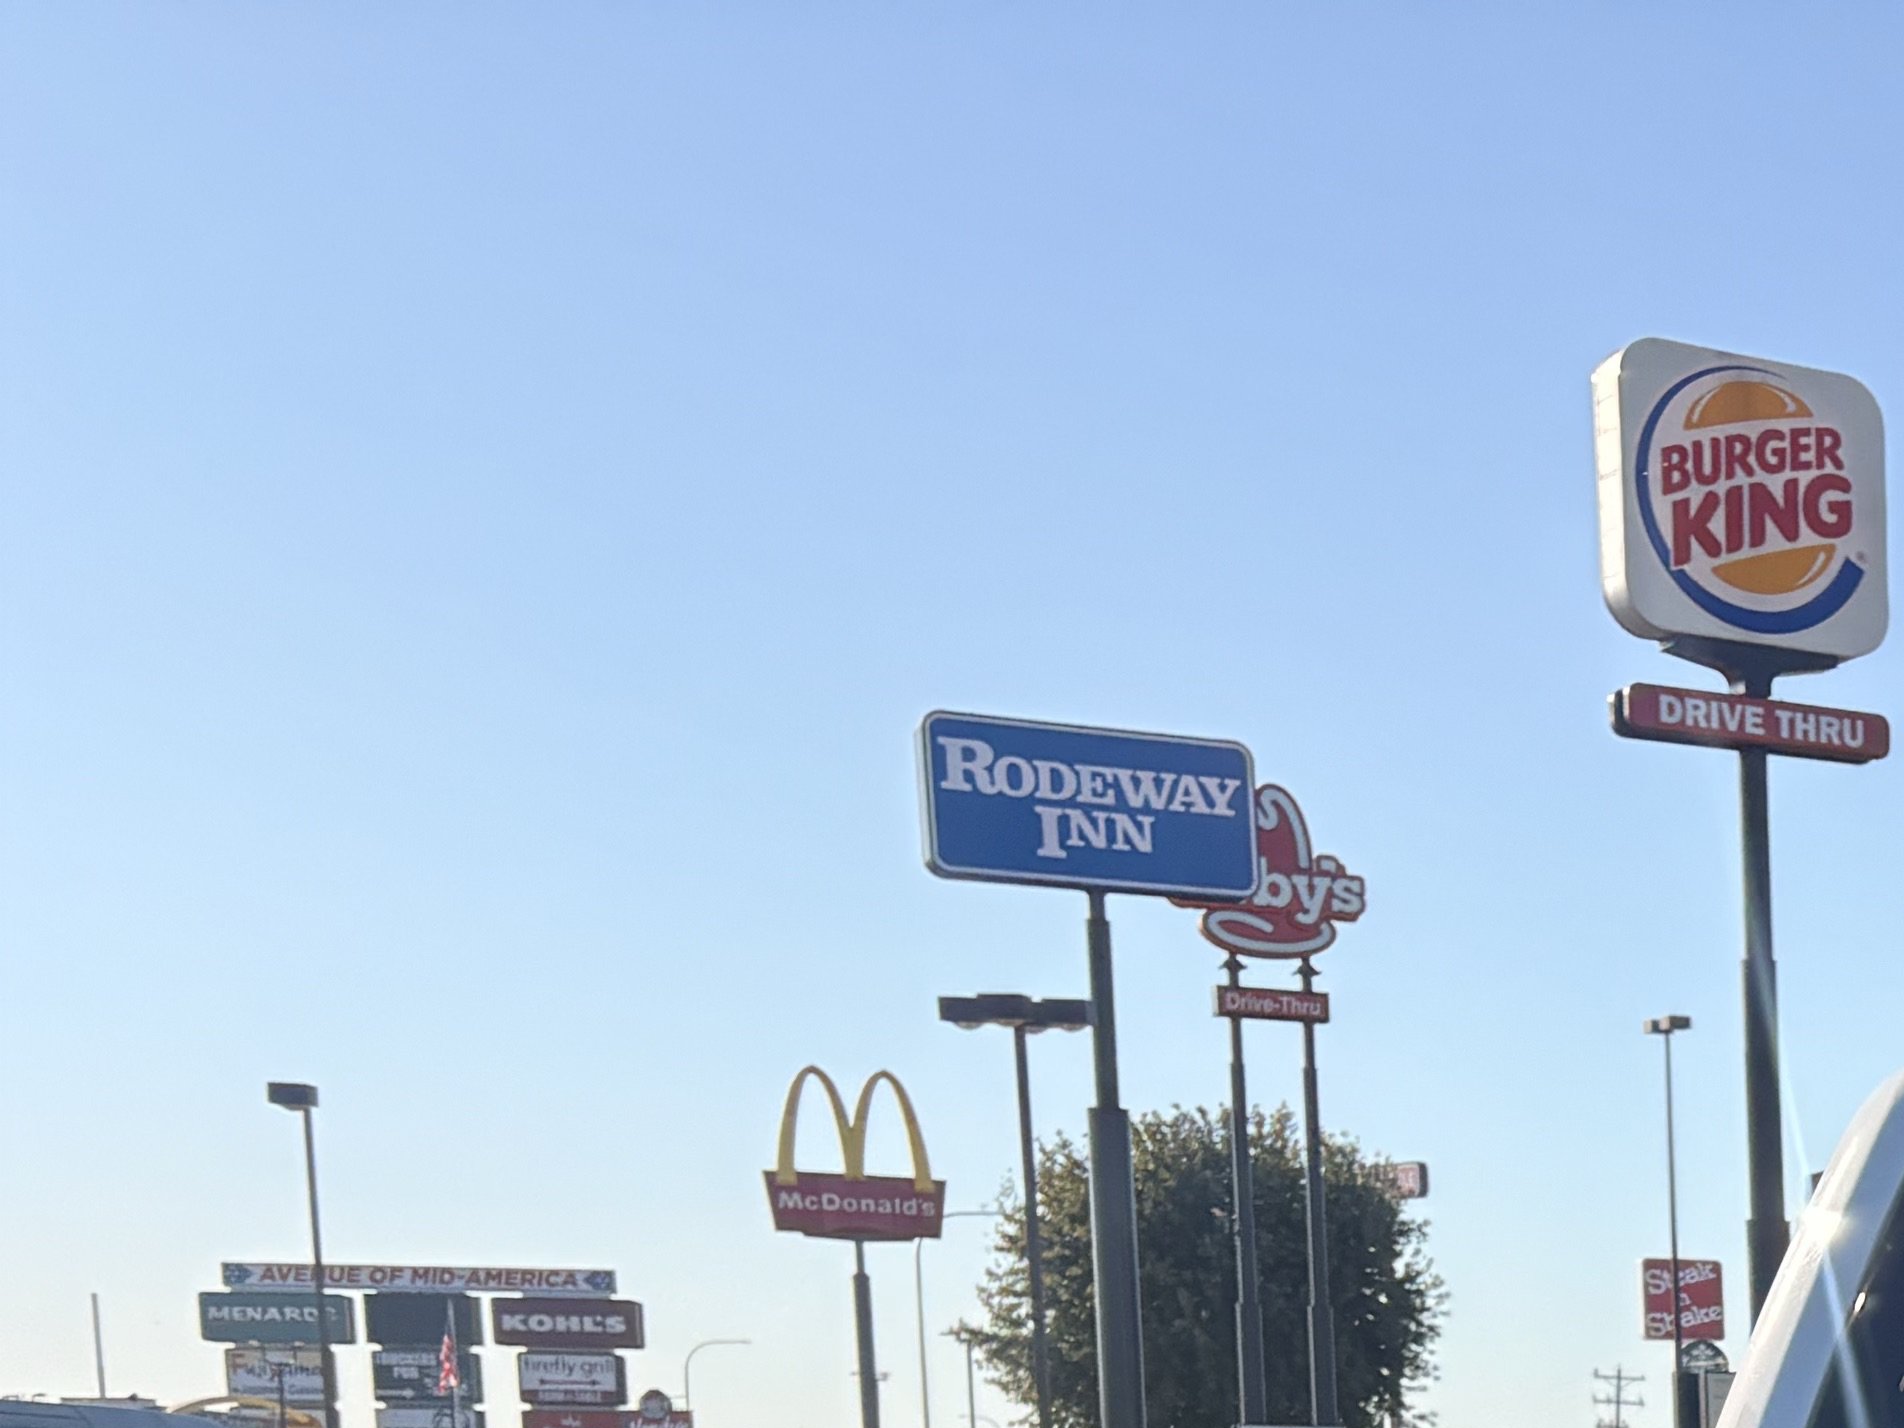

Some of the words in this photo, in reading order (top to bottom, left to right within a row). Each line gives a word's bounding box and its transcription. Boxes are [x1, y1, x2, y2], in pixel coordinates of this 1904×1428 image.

[1660, 426, 1844, 496] BURGER
[1671, 472, 1853, 570] KING
[1659, 693, 1766, 735] DRIVE
[1774, 709, 1864, 748] THRU
[937, 735, 1241, 818] RODEWAY
[1033, 805, 1156, 859] INN
[1252, 855, 1362, 924] by's
[1224, 991, 1322, 1016] Drive-Thru
[777, 1190, 936, 1217] McDonald's
[368, 1266, 402, 1285] OF
[409, 1268, 579, 1289] MID-AMERICA
[501, 1314, 626, 1334] KOHL'S
